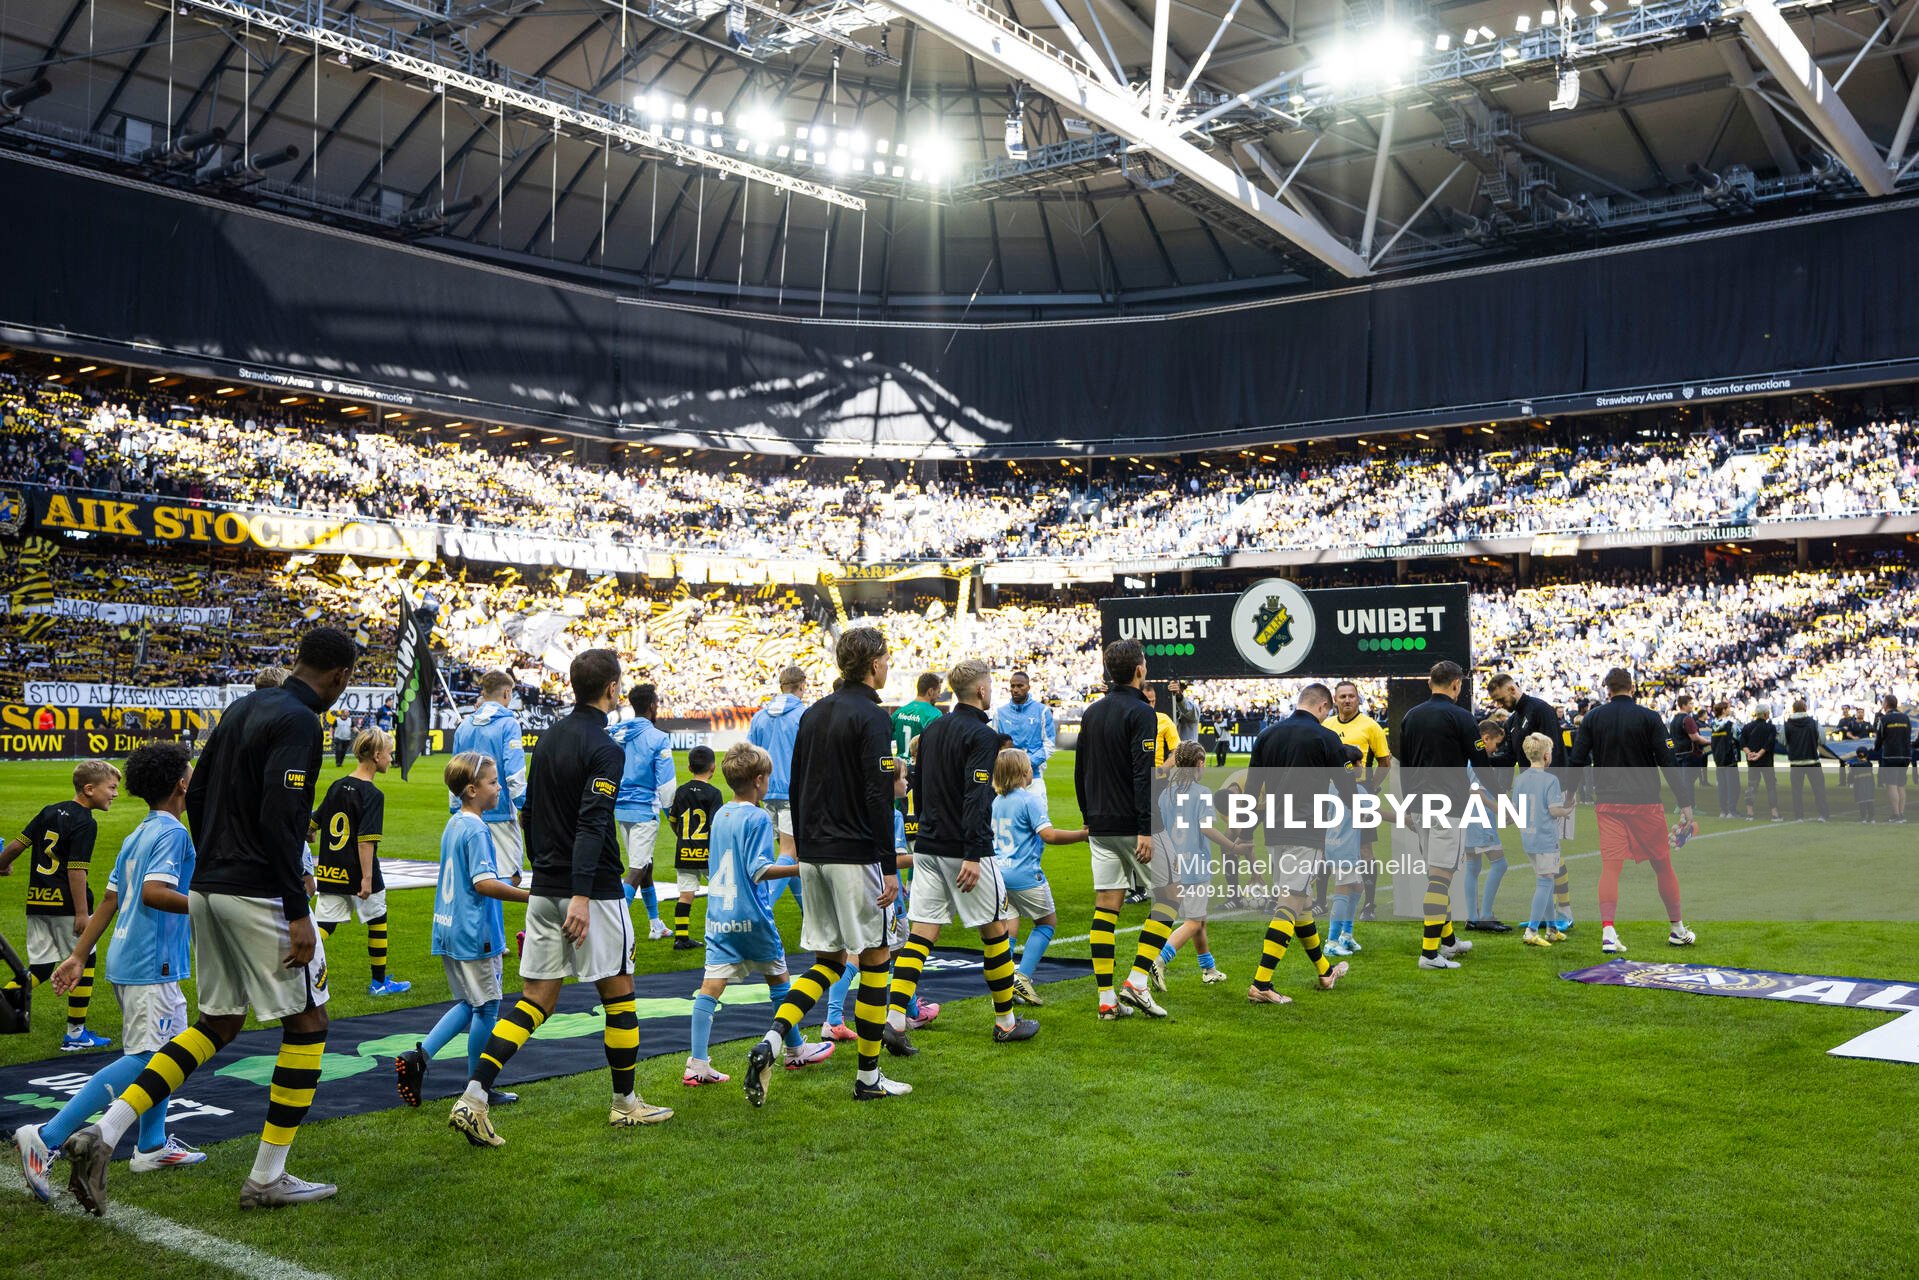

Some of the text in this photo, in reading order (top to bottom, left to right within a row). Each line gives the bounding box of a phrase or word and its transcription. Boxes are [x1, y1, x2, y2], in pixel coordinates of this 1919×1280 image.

[238, 368, 314, 389] Strawberry Arena
[1701, 379, 1791, 396] Room for emotions
[338, 383, 363, 397] Room
[376, 390, 413, 404] emotions
[1596, 390, 1673, 407] Strawberry Arena
[41, 494, 143, 537] AIK
[153, 506, 437, 563] STOCKHOLM
[1664, 526, 1760, 543] IDROTTSKLUBBEN
[1386, 542, 1466, 559] IDROTTSKLUBBEN
[1118, 615, 1211, 641] UNIBET
[1336, 606, 1446, 634] UNIBET
[29, 682, 80, 705] STÖD
[1, 734, 64, 752] TOWN
[669, 732, 714, 750] NIBET
[902, 725, 912, 757] 1
[595, 781, 616, 793] UNIBET
[328, 811, 350, 851] 9
[680, 808, 709, 840] 12
[904, 822, 919, 832] SVE
[36, 830, 60, 875] 3
[680, 847, 709, 858] SVEA
[316, 865, 350, 880] SVEA
[707, 848, 738, 911] 4
[27, 887, 64, 901] SVEA
[1767, 979, 1919, 1011] AL
